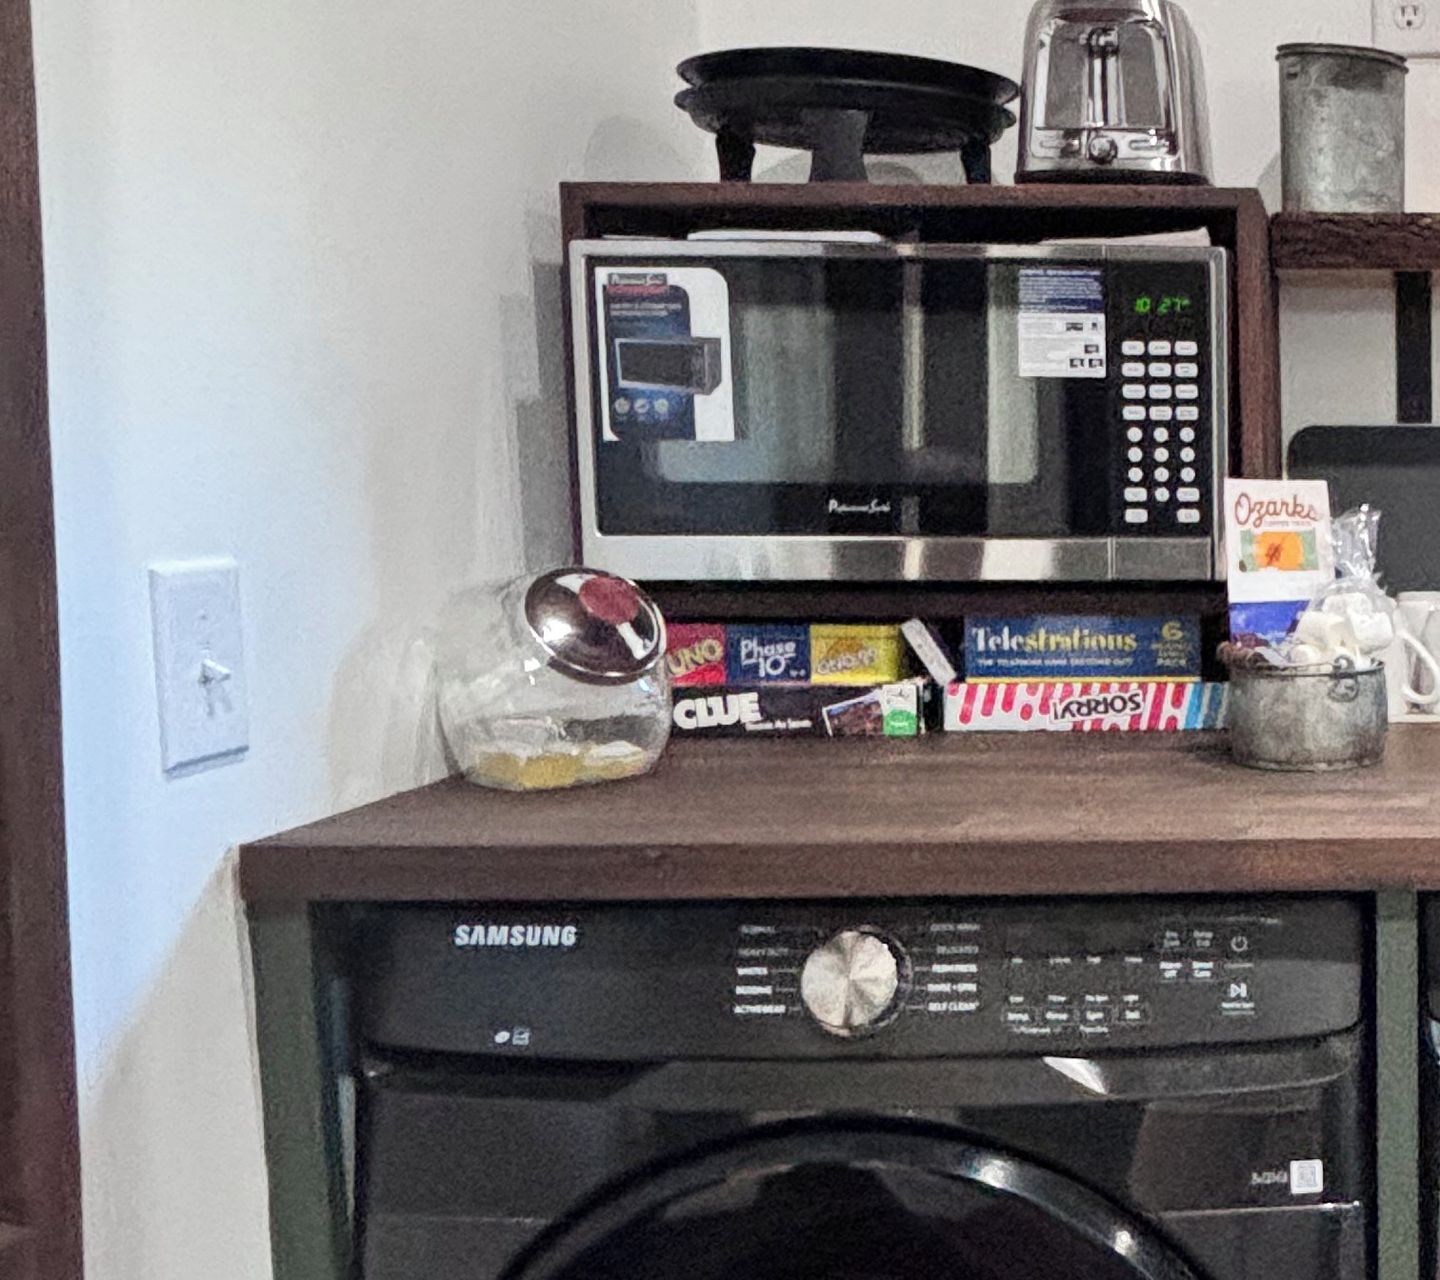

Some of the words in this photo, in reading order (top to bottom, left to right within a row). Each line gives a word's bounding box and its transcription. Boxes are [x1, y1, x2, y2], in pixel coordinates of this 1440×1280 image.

[740, 637, 796, 666] Phase
[971, 624, 1138, 652] Telestrations
[665, 638, 723, 676] UNO
[758, 656, 786, 677] 10
[673, 691, 762, 729] CLUE
[1053, 693, 1142, 721] SORRY!
[454, 924, 577, 946] SAMSUNG
